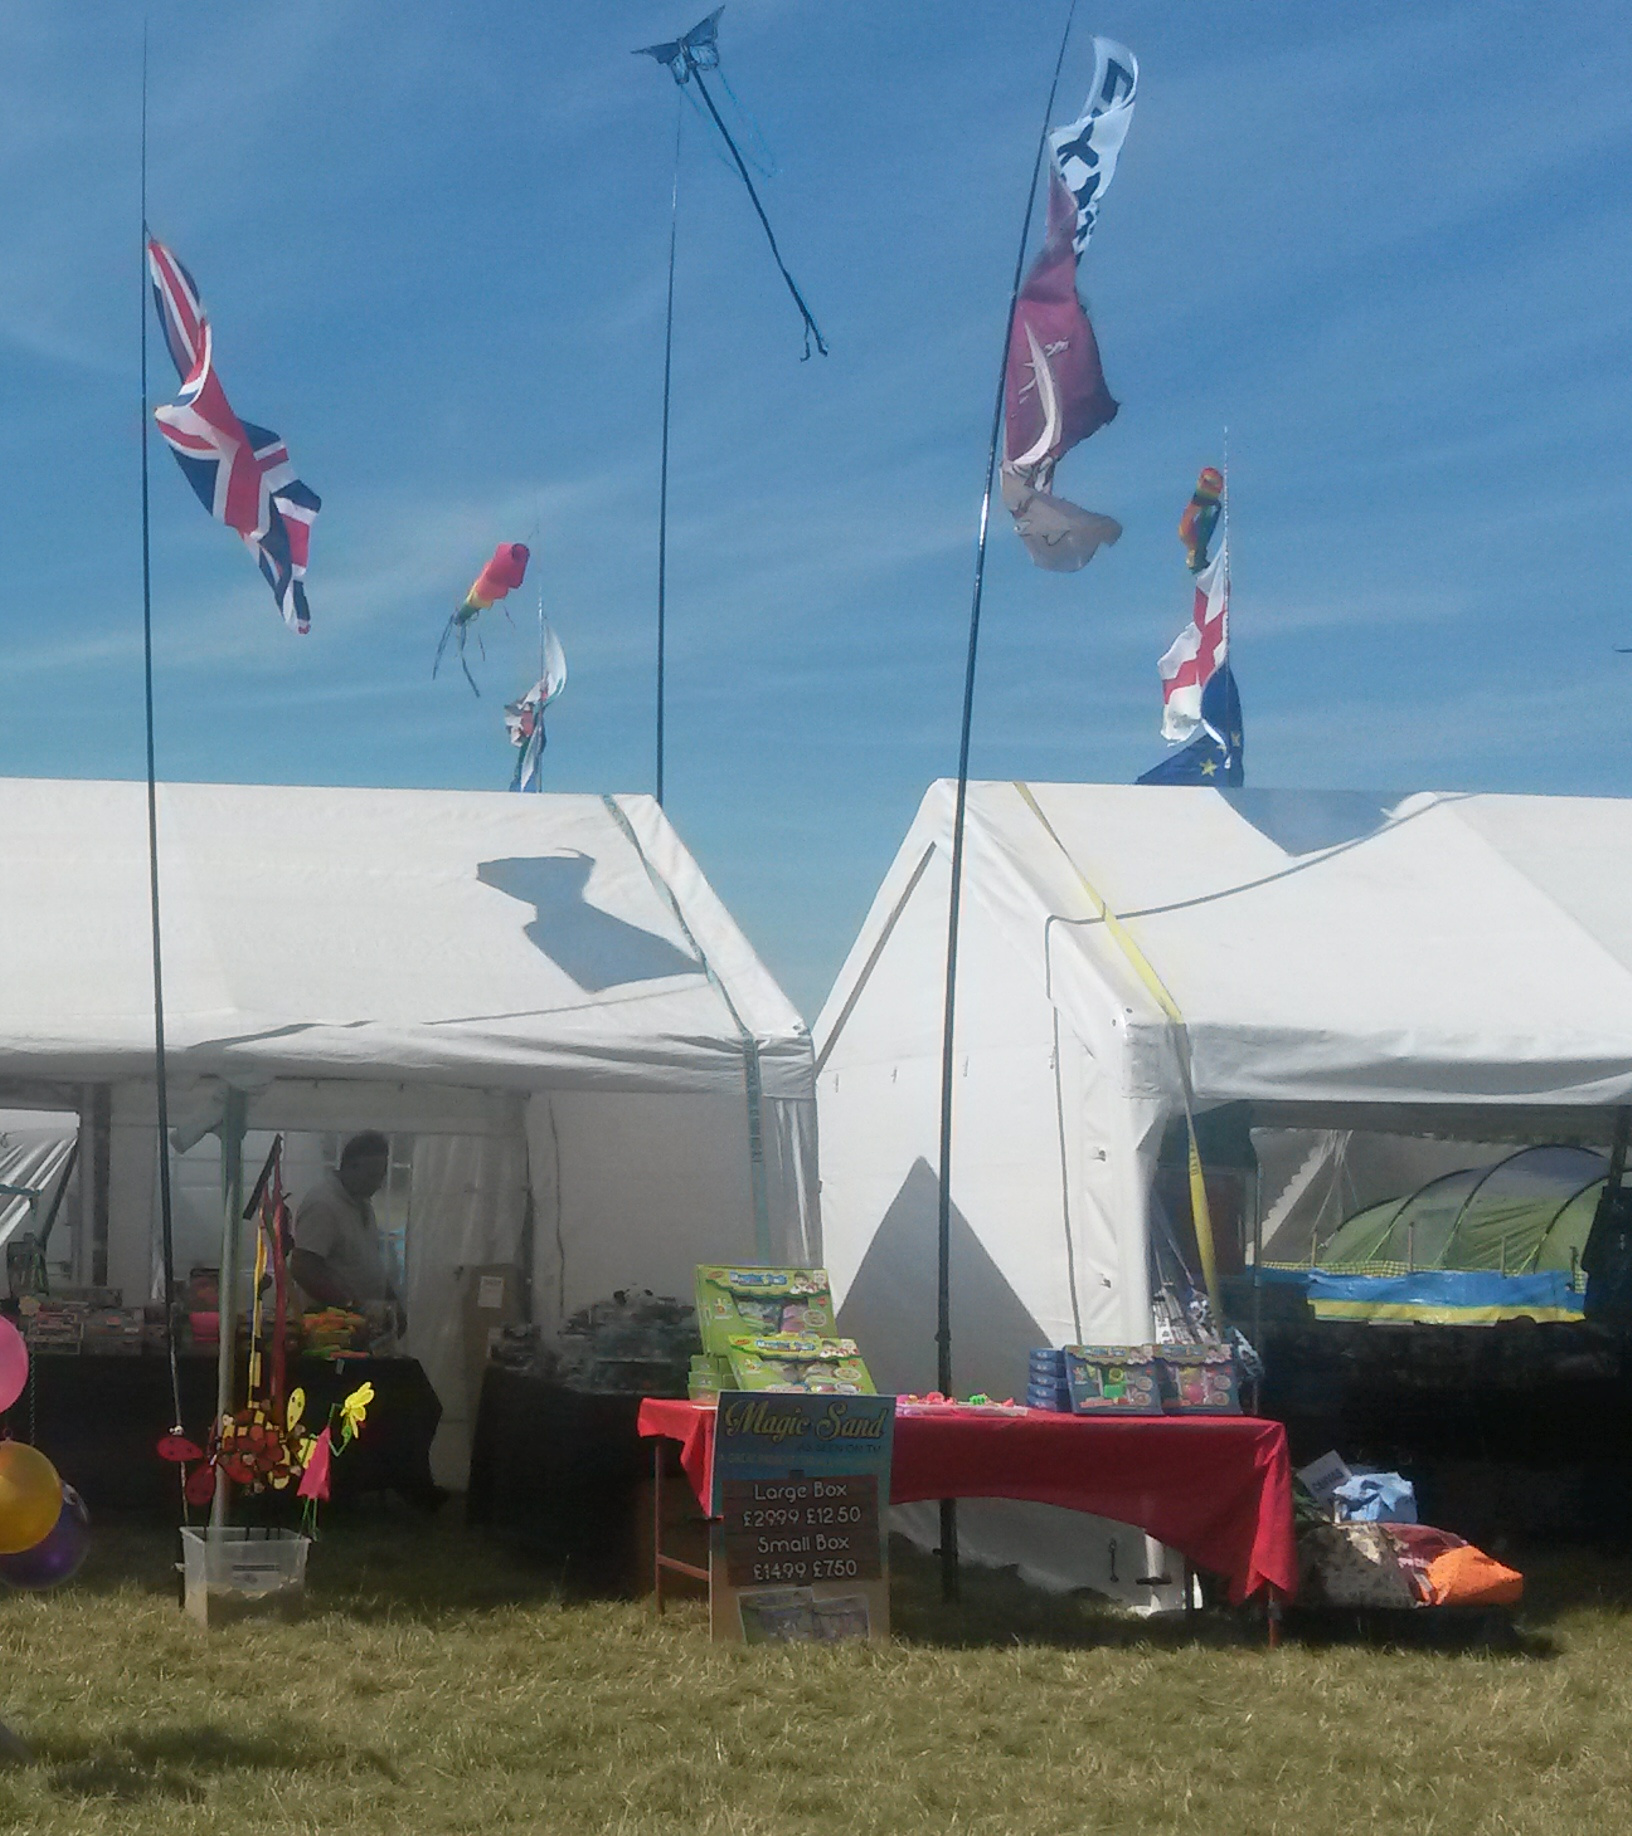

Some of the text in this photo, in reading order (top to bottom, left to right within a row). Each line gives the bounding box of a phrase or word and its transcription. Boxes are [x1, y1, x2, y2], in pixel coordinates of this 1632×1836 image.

[725, 1400, 889, 1442] Magic Sand
[754, 1481, 847, 1503] Large Box
[757, 1534, 849, 1553] Small Box
